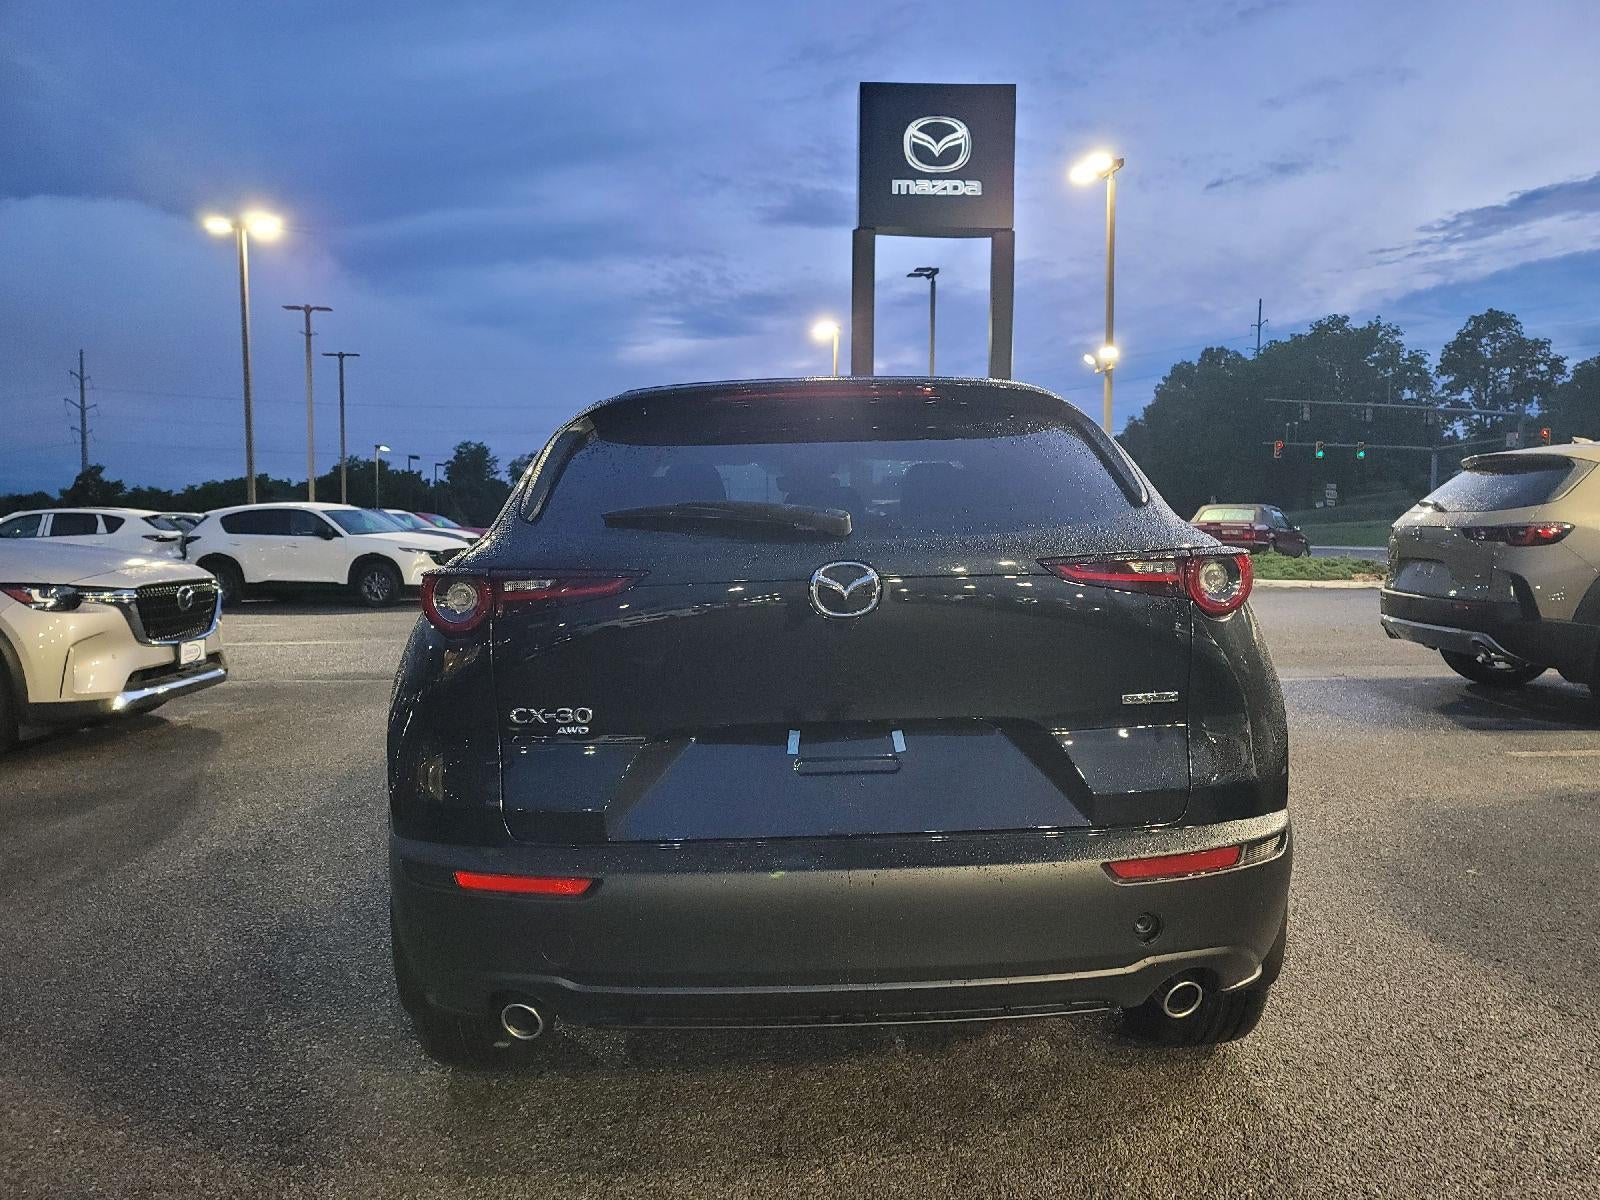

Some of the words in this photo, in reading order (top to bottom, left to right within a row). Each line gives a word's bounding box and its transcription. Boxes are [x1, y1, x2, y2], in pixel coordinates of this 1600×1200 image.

[891, 179, 983, 196] mazda
[509, 707, 593, 724] CX-30
[556, 726, 590, 735] AWD
